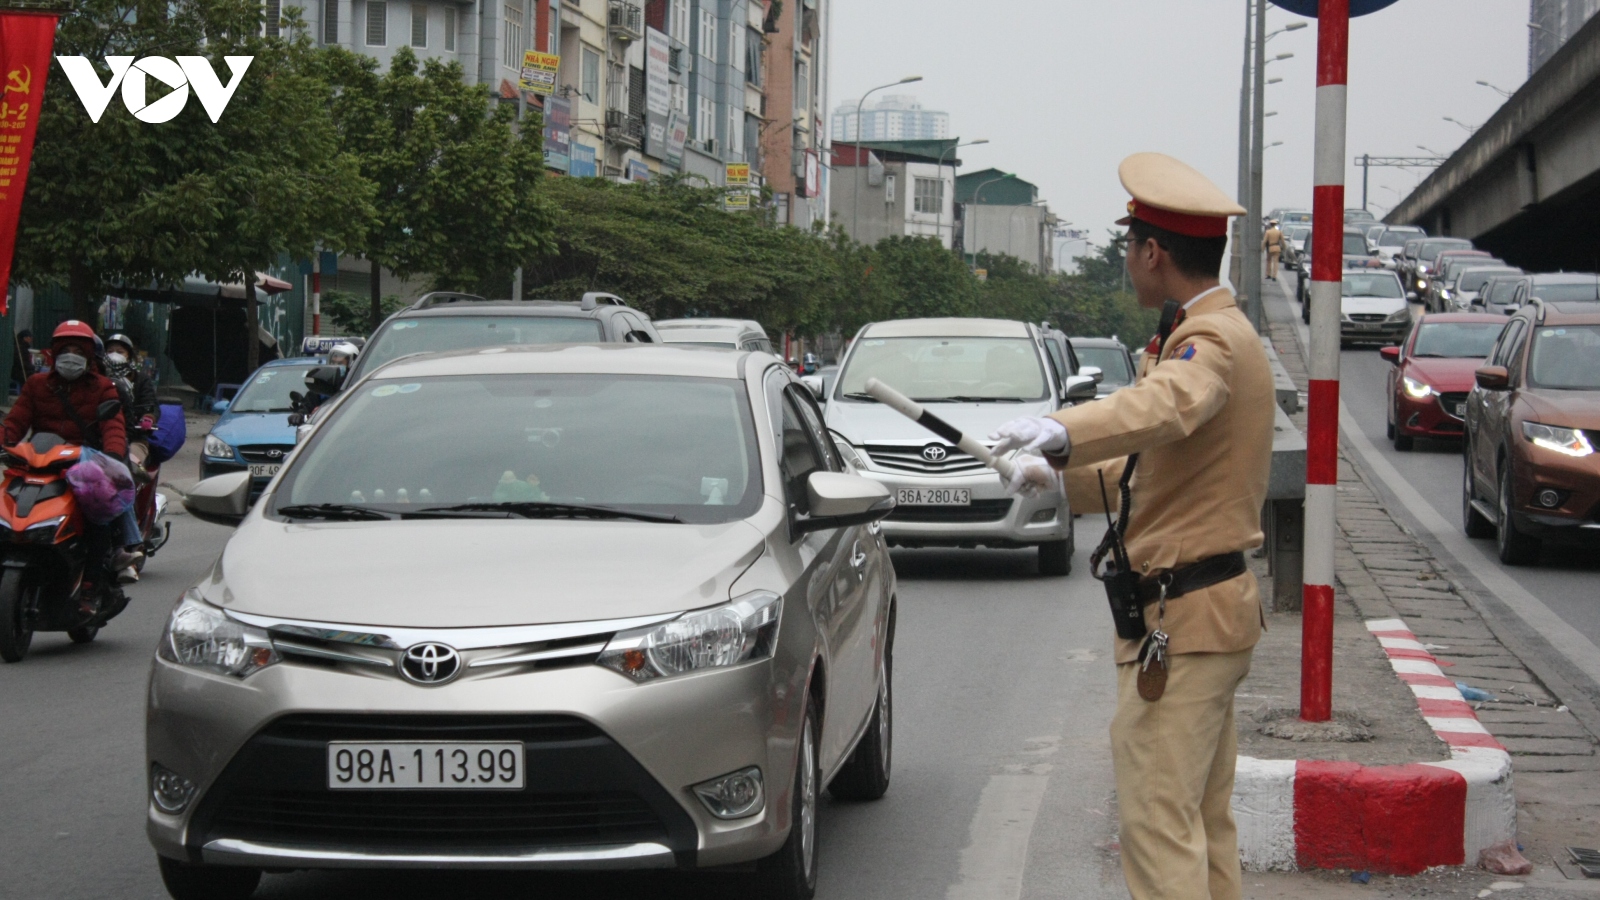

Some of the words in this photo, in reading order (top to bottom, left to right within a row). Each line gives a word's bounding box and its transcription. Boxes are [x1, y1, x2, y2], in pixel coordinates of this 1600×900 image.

[525, 53, 539, 63] NHÀ
[320, 342, 333, 351] SAO
[899, 490, 968, 503] 36A-280.43
[336, 749, 516, 783] 98A-113.99
